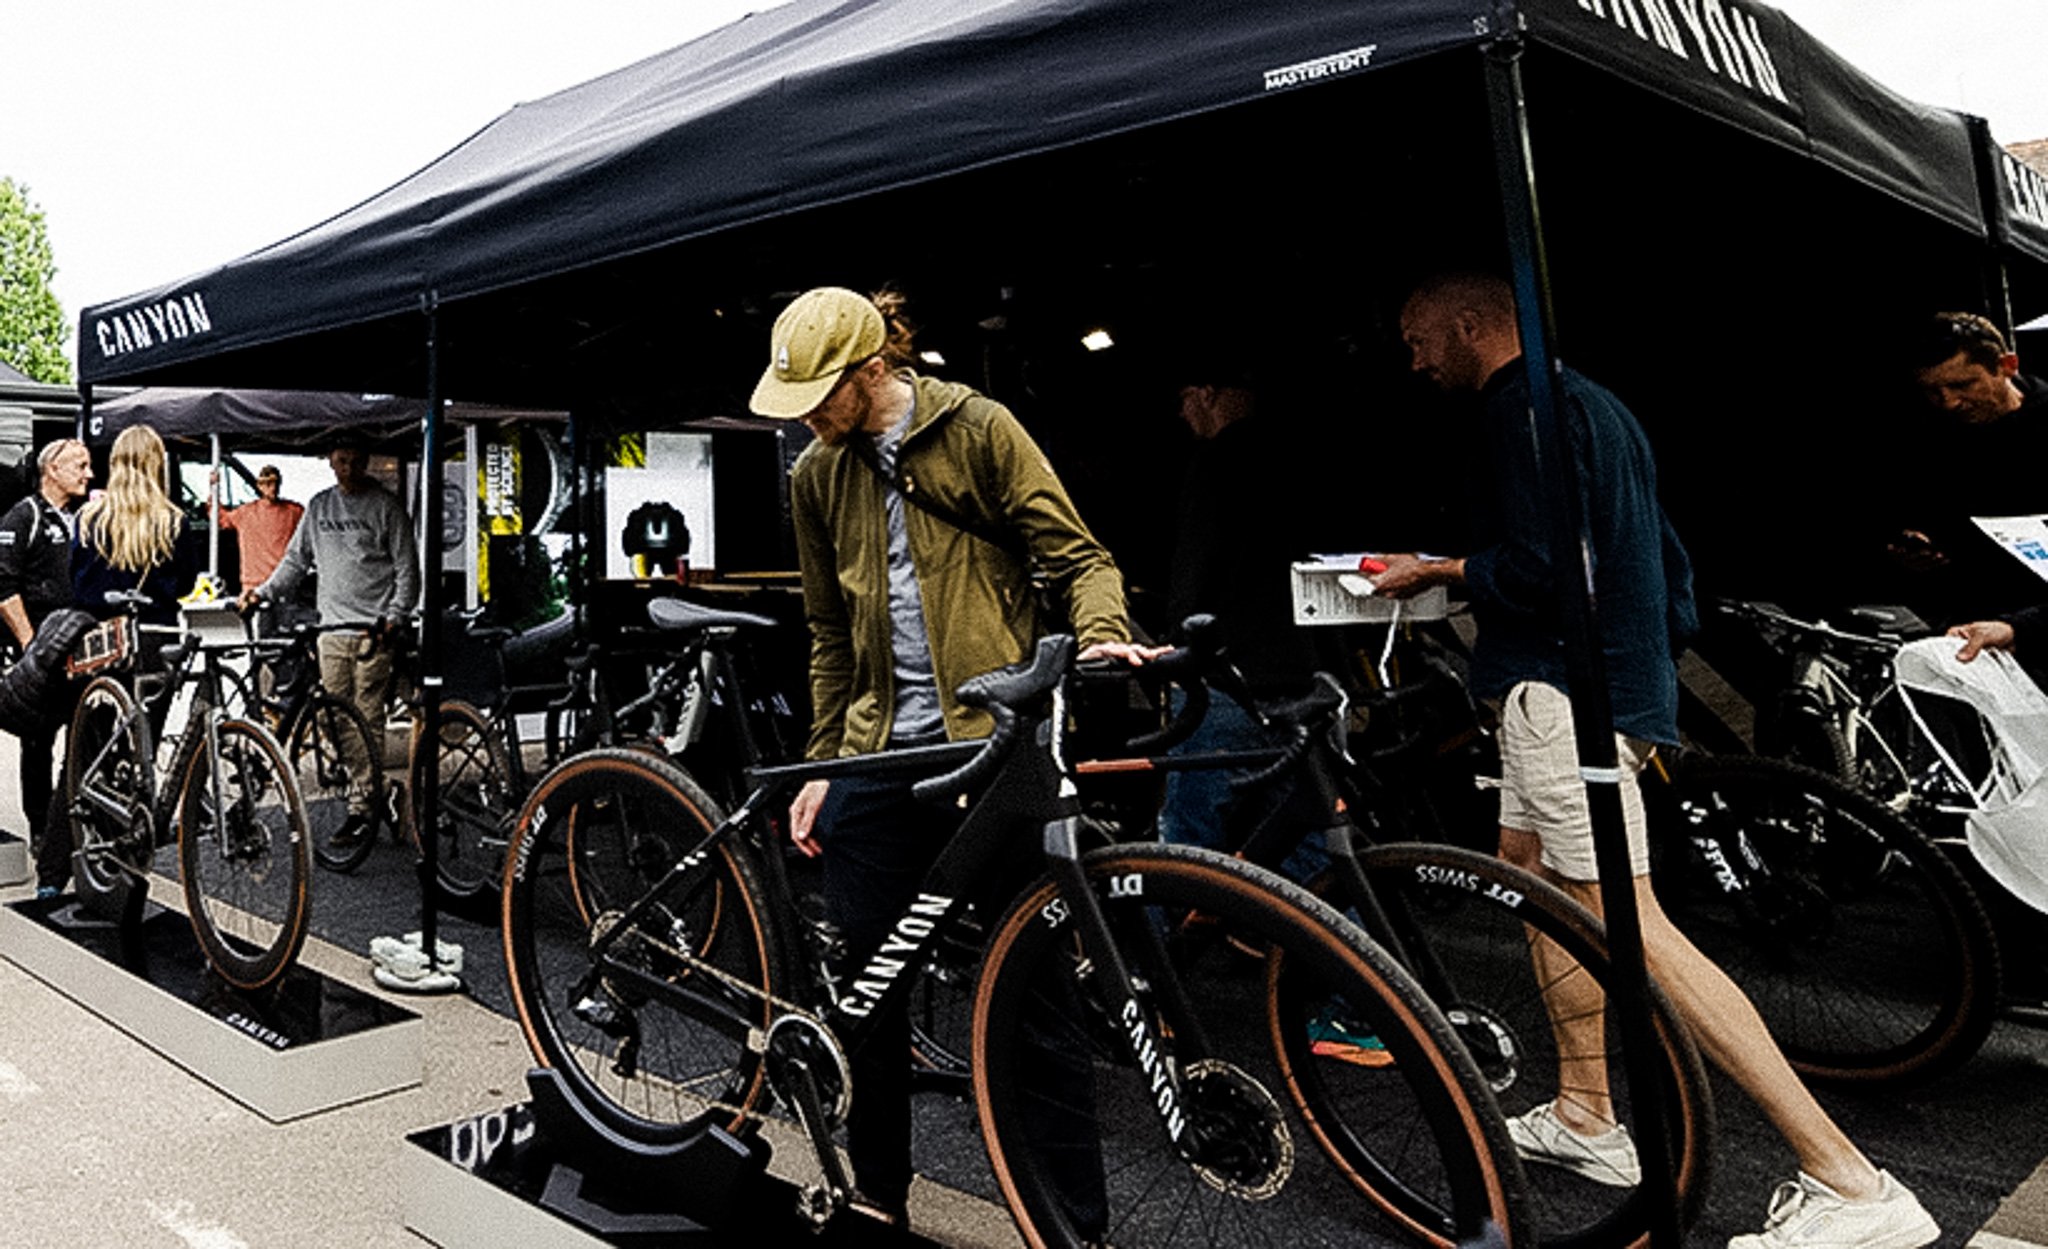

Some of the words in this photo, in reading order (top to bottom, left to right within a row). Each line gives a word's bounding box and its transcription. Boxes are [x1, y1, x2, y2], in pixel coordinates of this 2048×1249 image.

[1263, 50, 1374, 91] MASTERTENT
[1577, 0, 1789, 104] NYON
[96, 291, 211, 358] CANYON
[1108, 873, 1142, 898] DT
[1415, 864, 1480, 892] SWISS
[1482, 883, 1524, 908] DT
[839, 893, 953, 1017] CANYON
[226, 1013, 289, 1048] CANYON
[1122, 999, 1185, 1142] CANYON
